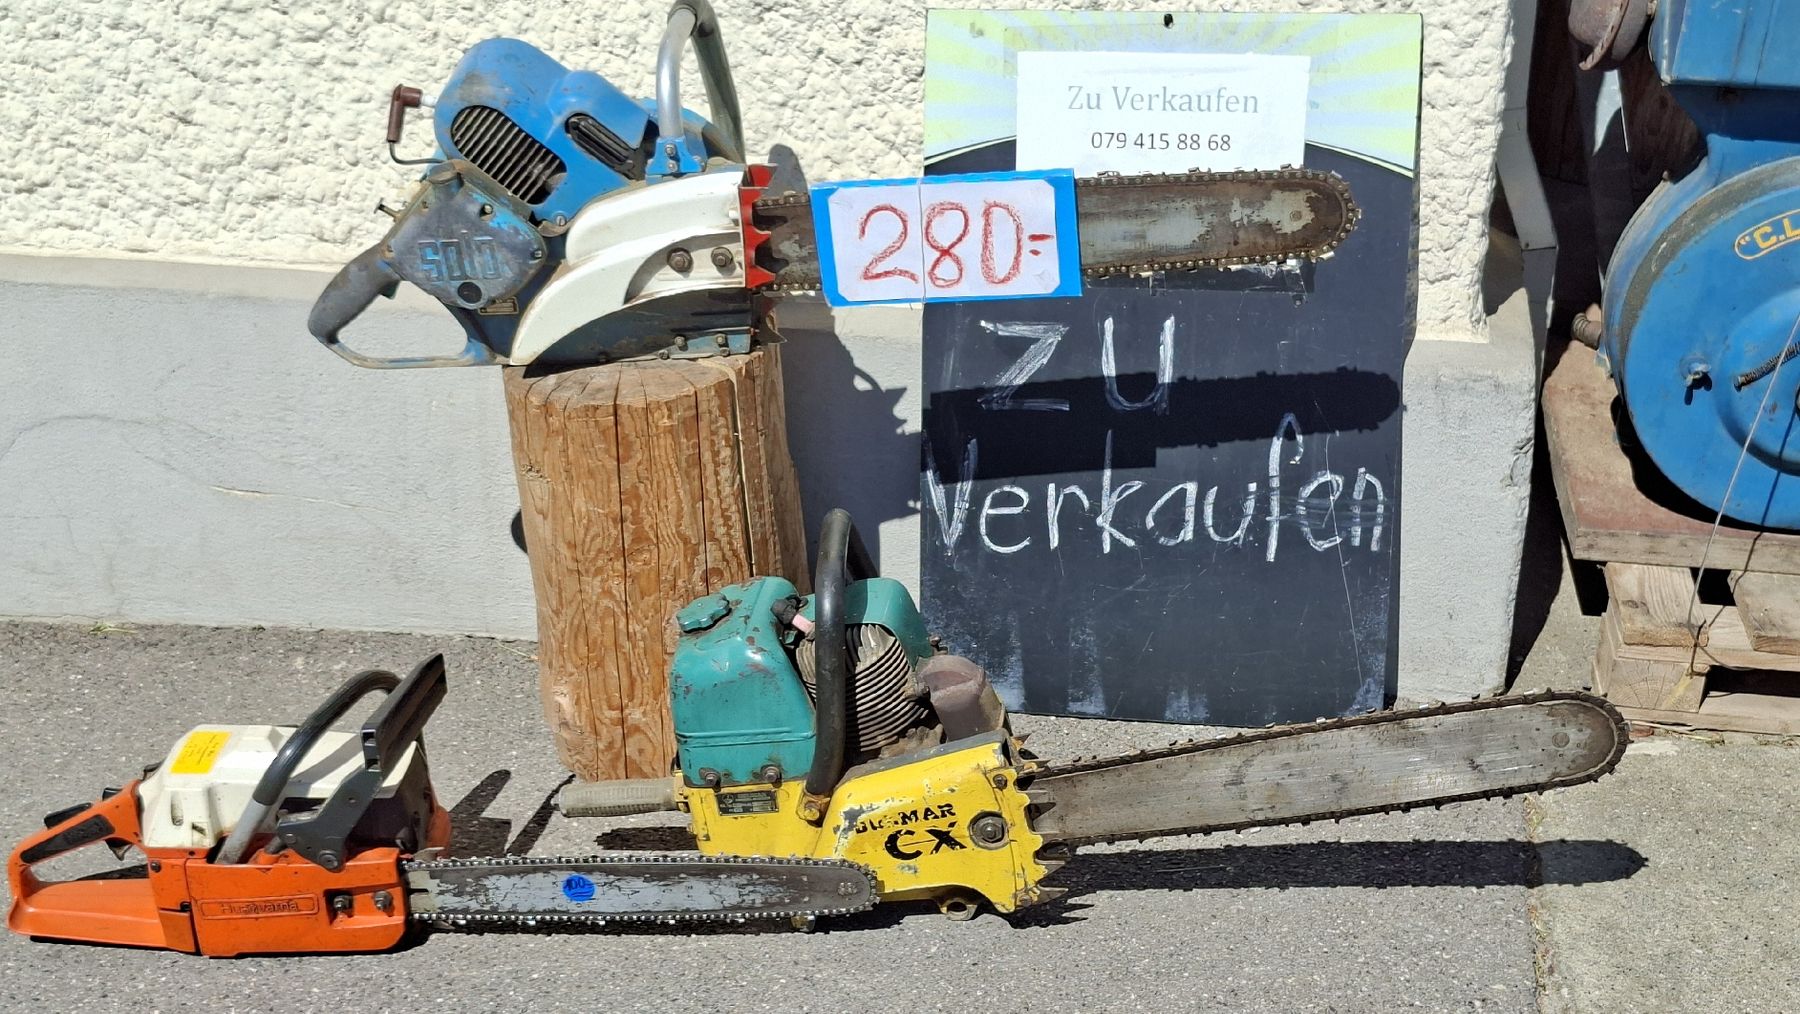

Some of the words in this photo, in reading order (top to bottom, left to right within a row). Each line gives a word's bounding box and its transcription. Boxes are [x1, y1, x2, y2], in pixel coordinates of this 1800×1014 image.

[1067, 85, 1102, 110] Zu
[1111, 85, 1259, 114] Verkaufen
[1091, 131, 1127, 149] 079
[1133, 132, 1170, 150] 415
[1177, 133, 1201, 151] 88
[1207, 134, 1231, 151] 68
[921, 412, 1386, 563] Verkaufen
[884, 820, 968, 861] CX
